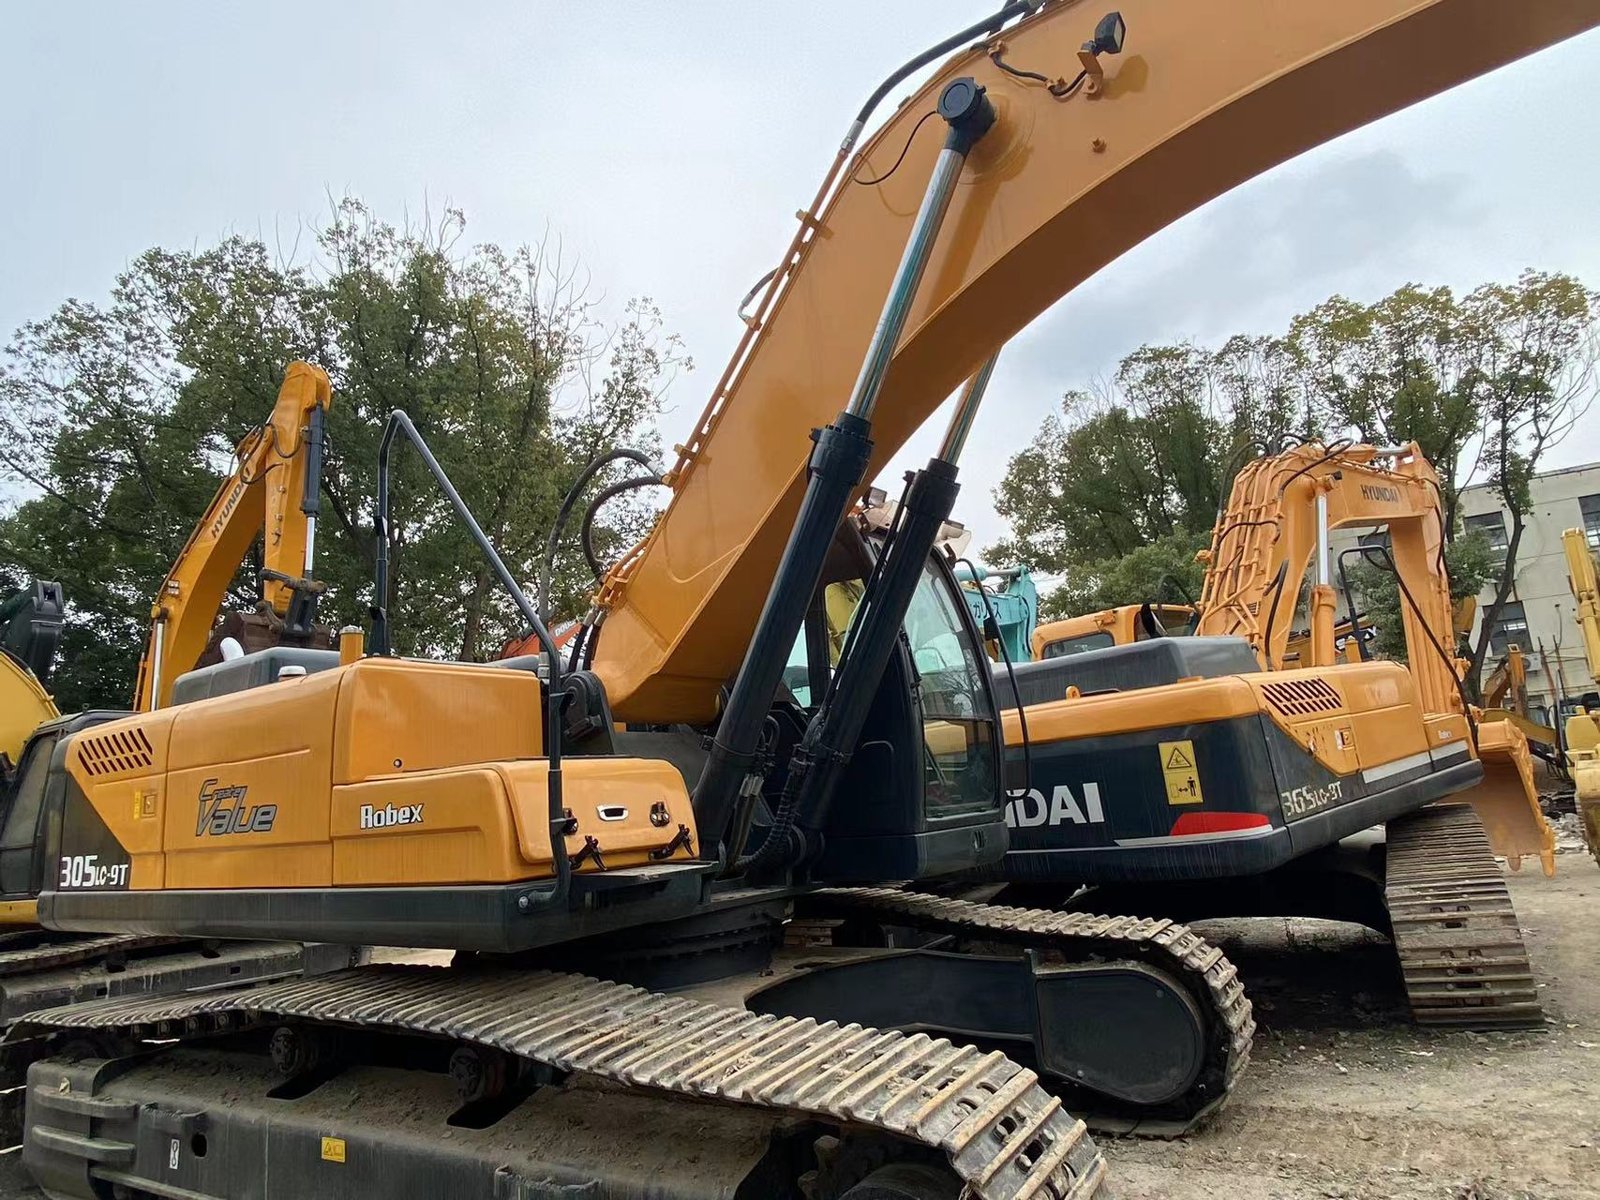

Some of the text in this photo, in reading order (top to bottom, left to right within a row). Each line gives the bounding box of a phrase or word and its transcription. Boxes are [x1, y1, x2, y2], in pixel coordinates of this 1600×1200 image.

[199, 778, 242, 801] Create
[196, 785, 277, 837] Value
[360, 802, 424, 830] Robex
[60, 855, 129, 888] 305LC-9T
